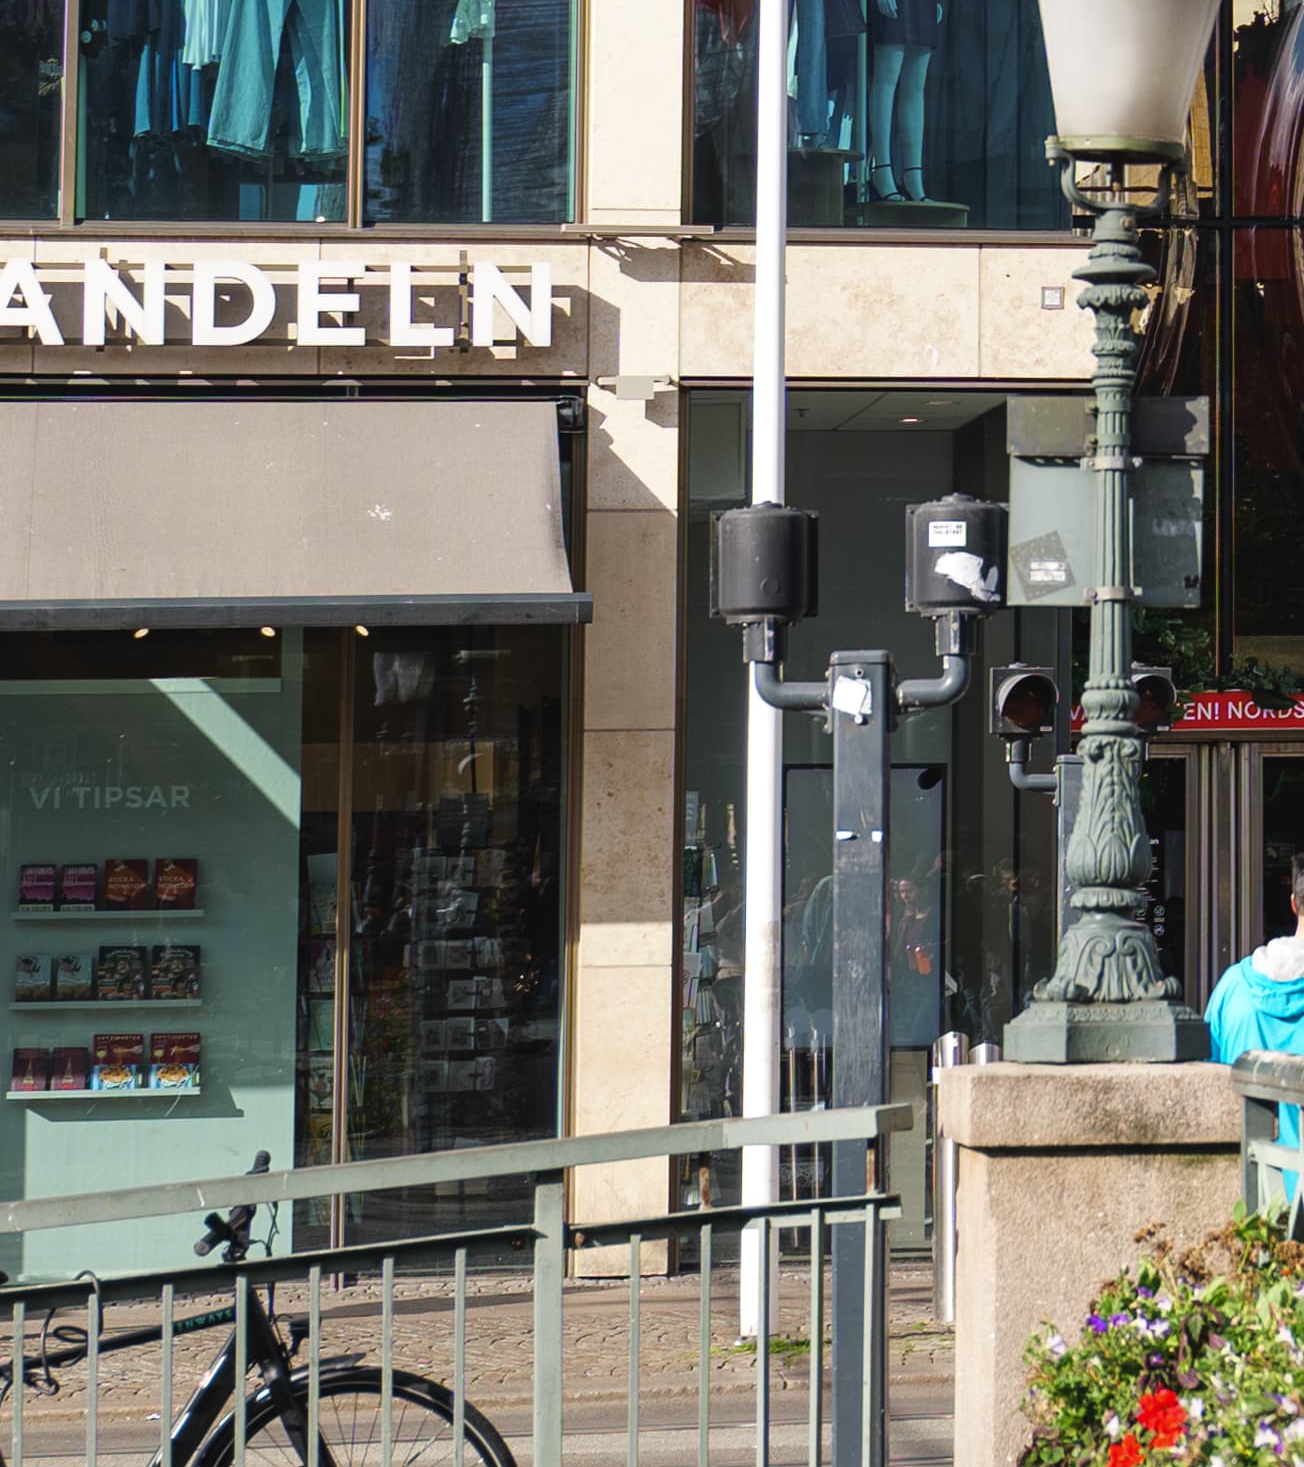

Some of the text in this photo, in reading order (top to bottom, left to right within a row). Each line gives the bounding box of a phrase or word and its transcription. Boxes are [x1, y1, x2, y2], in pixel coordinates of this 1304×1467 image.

[0, 258, 553, 348] ANDELN
[1182, 700, 1220, 721] EN!
[29, 784, 191, 810] VI TIPSAR
